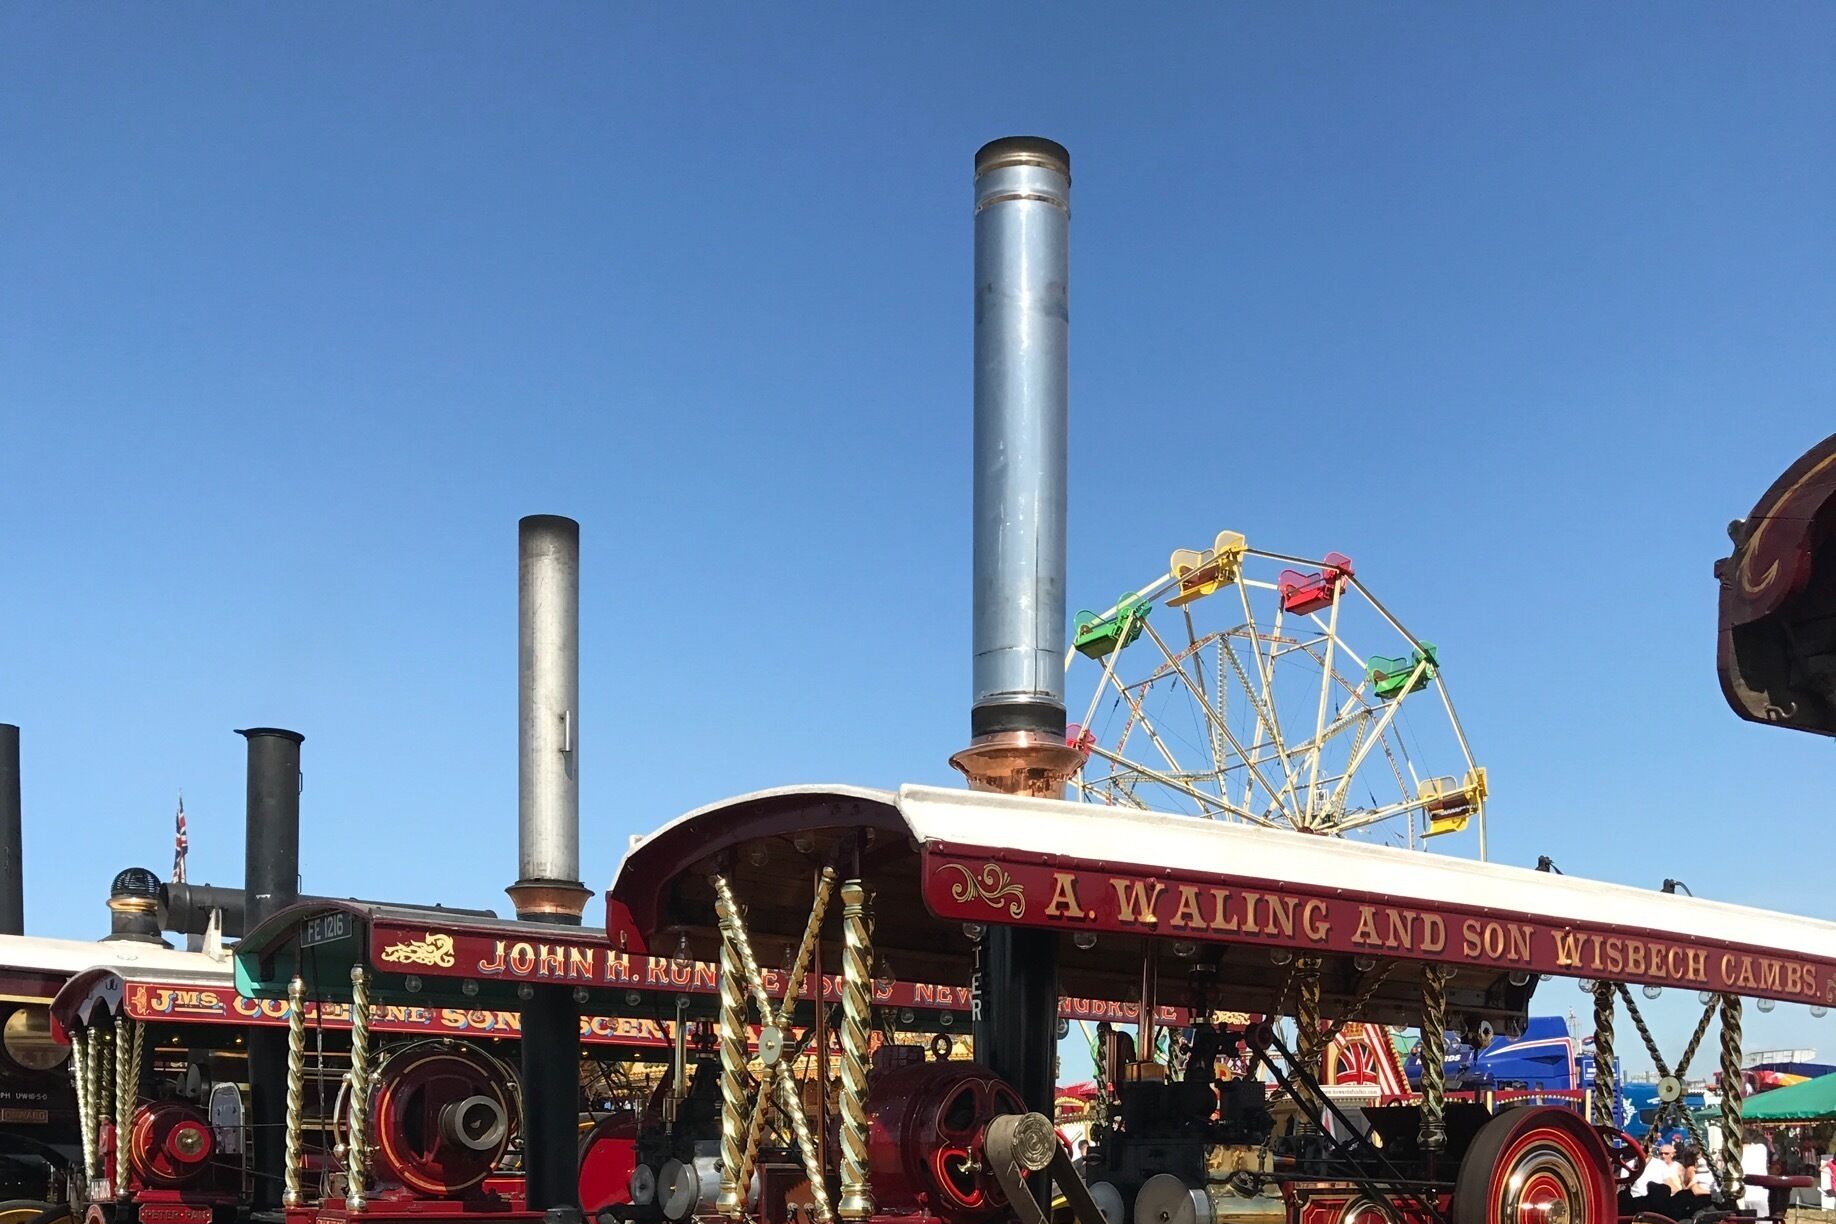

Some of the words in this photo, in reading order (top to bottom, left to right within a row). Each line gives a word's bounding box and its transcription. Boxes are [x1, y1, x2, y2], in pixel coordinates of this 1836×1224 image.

[308, 919, 322, 942] FE
[324, 915, 344, 938] 1216
[1045, 872, 1095, 919] A.
[1110, 878, 1331, 941] WALING
[1352, 905, 1446, 952] AND
[1463, 918, 1535, 961] SON
[1552, 929, 1709, 982] WISBECH
[1721, 953, 1821, 998] CAMBS.
[479, 941, 595, 978] JOHN
[608, 950, 640, 982] H.
